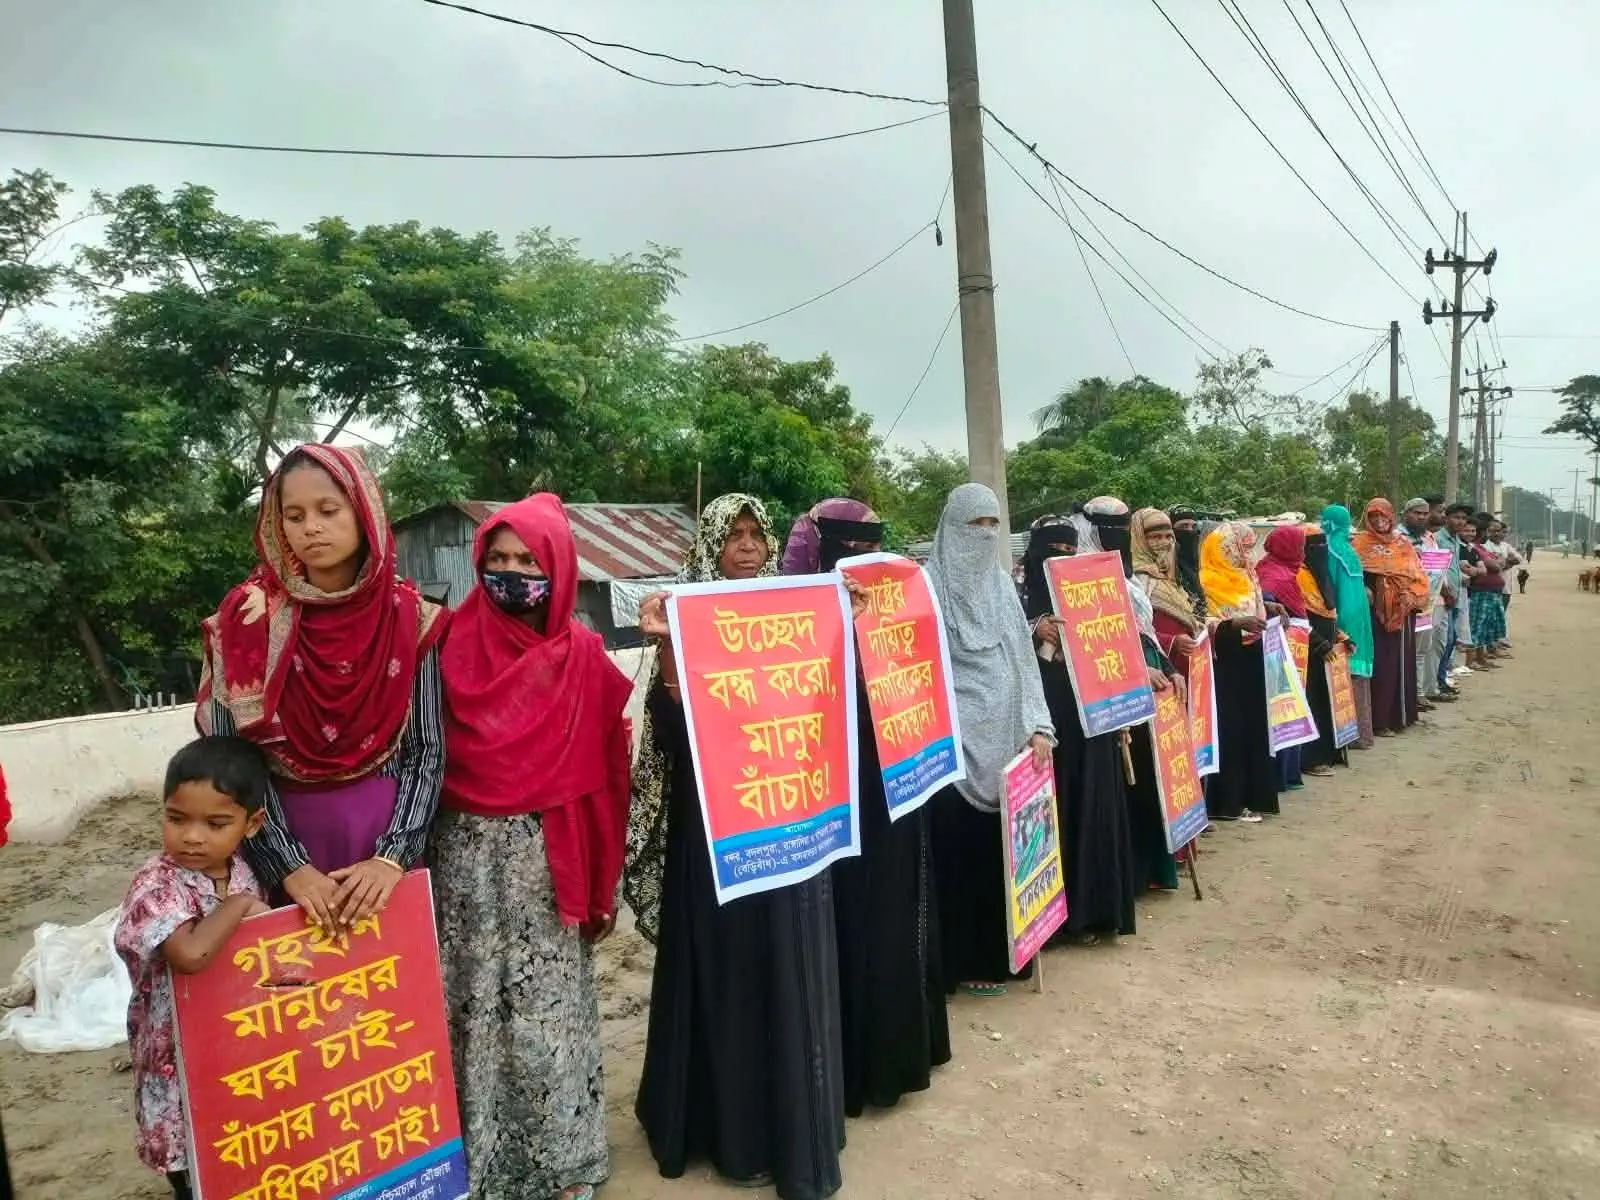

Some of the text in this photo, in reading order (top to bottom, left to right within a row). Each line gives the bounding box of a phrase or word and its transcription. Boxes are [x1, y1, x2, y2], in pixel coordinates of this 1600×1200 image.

[714, 605, 816, 654] উচ্ছেদ
[704, 654, 839, 710] বন্ধ করো,
[740, 712, 824, 762] মানুষ
[222, 955, 401, 1039] মানুষের
[220, 1050, 301, 1100] ঘর
[213, 1102, 316, 1169] বাঁচার
[228, 1140, 363, 1200] ধিকার
